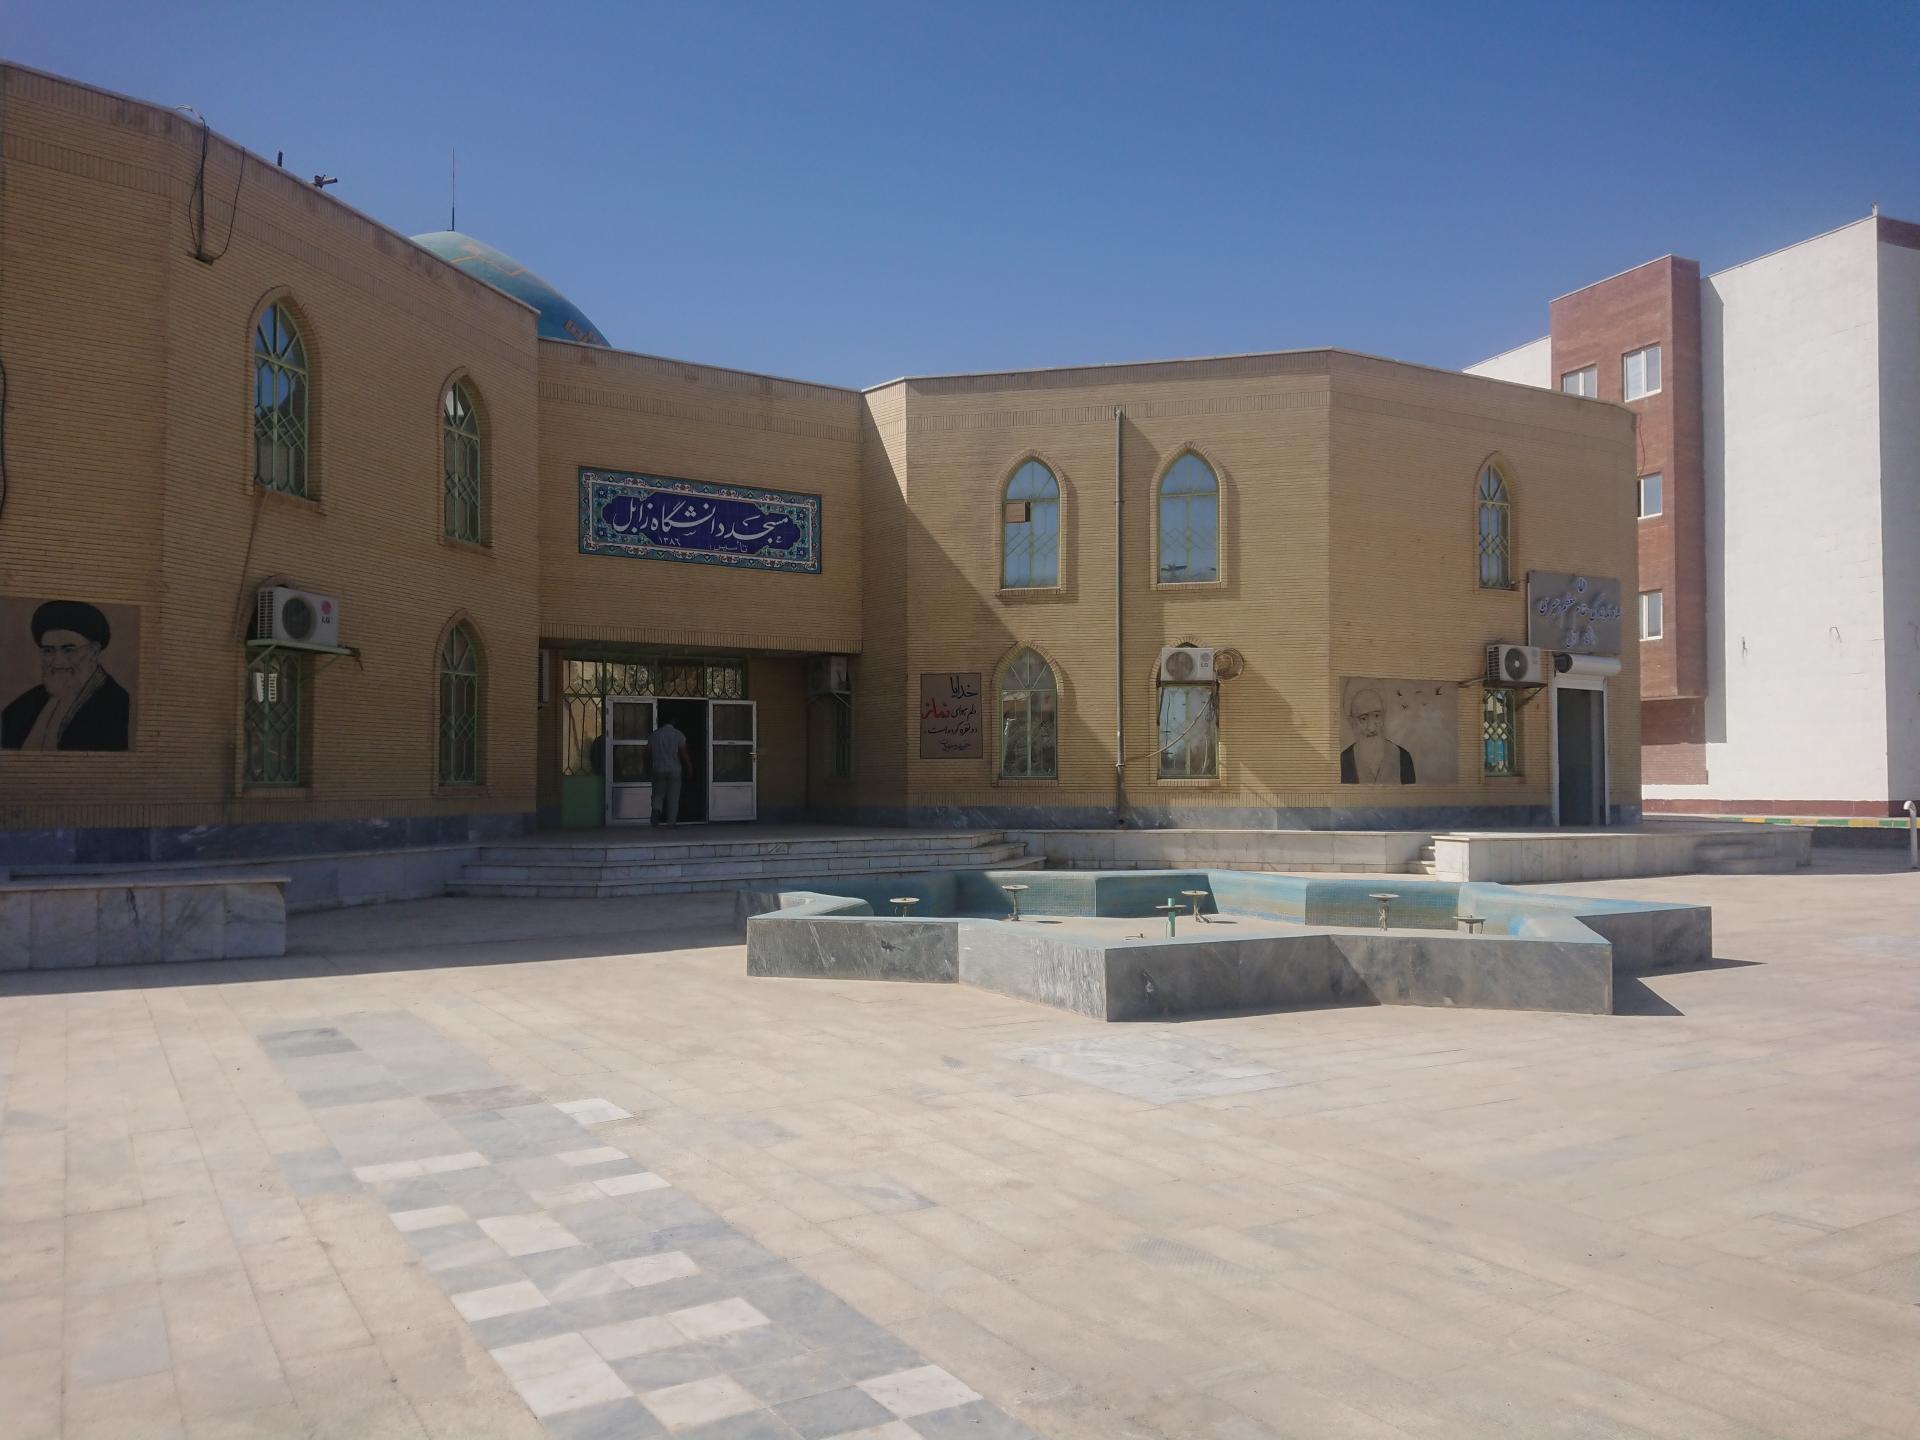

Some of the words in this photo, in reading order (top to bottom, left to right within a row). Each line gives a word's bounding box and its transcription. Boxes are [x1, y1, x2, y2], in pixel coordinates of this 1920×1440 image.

[612, 497, 654, 533] زابل
[650, 500, 724, 538] دانشگاه
[722, 513, 789, 544] مسجد
[657, 536, 682, 547] ۱۳۸۶
[949, 675, 979, 699] خدایا
[921, 697, 950, 719] نماز
[966, 703, 977, 721] دلم
